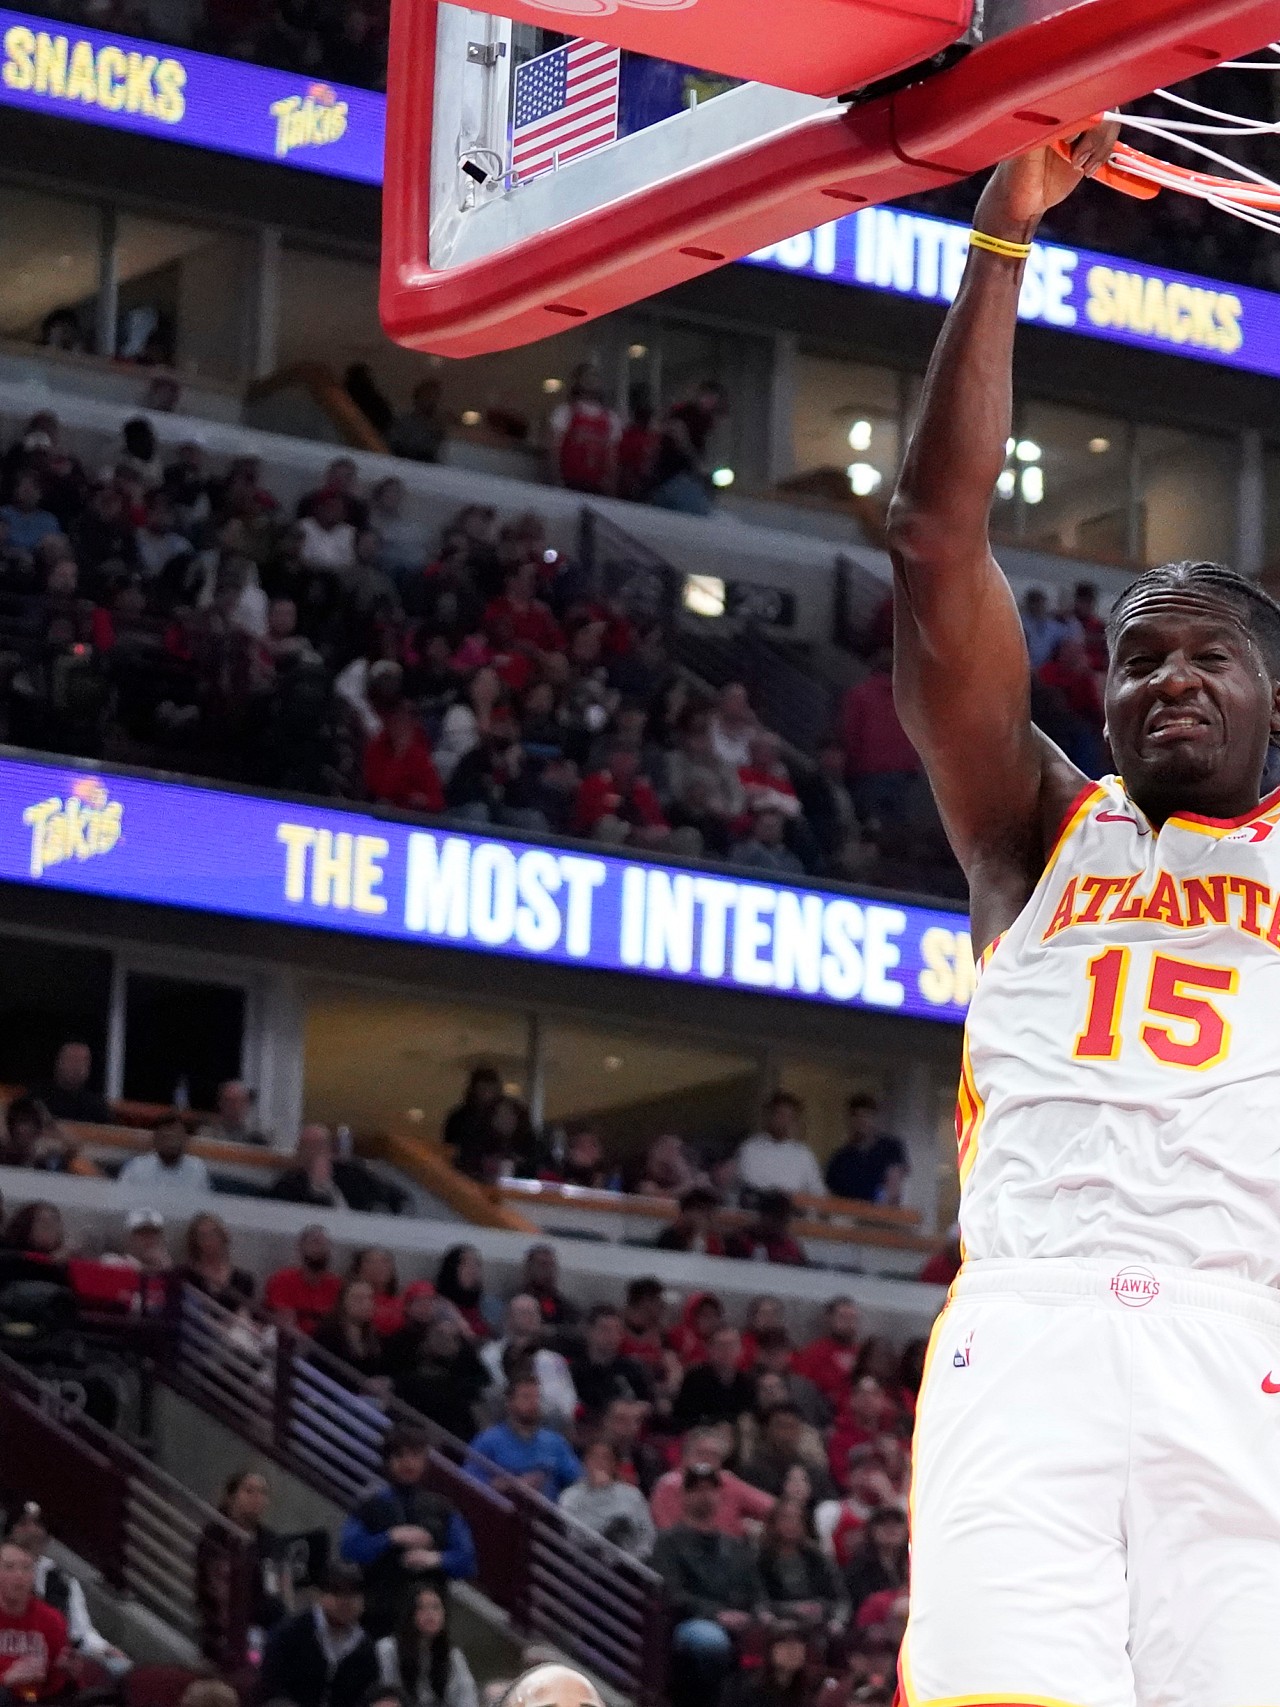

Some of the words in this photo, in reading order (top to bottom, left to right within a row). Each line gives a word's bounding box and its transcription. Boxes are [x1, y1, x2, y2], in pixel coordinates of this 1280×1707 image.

[3, 26, 187, 124] SNACKS
[1086, 265, 1243, 353] SNACKS
[276, 822, 389, 915] THE
[404, 831, 607, 957] MOST
[620, 866, 906, 1006] INTENSE
[1072, 945, 1241, 1072] 15
[1110, 1277, 1160, 1295] HAWKS
